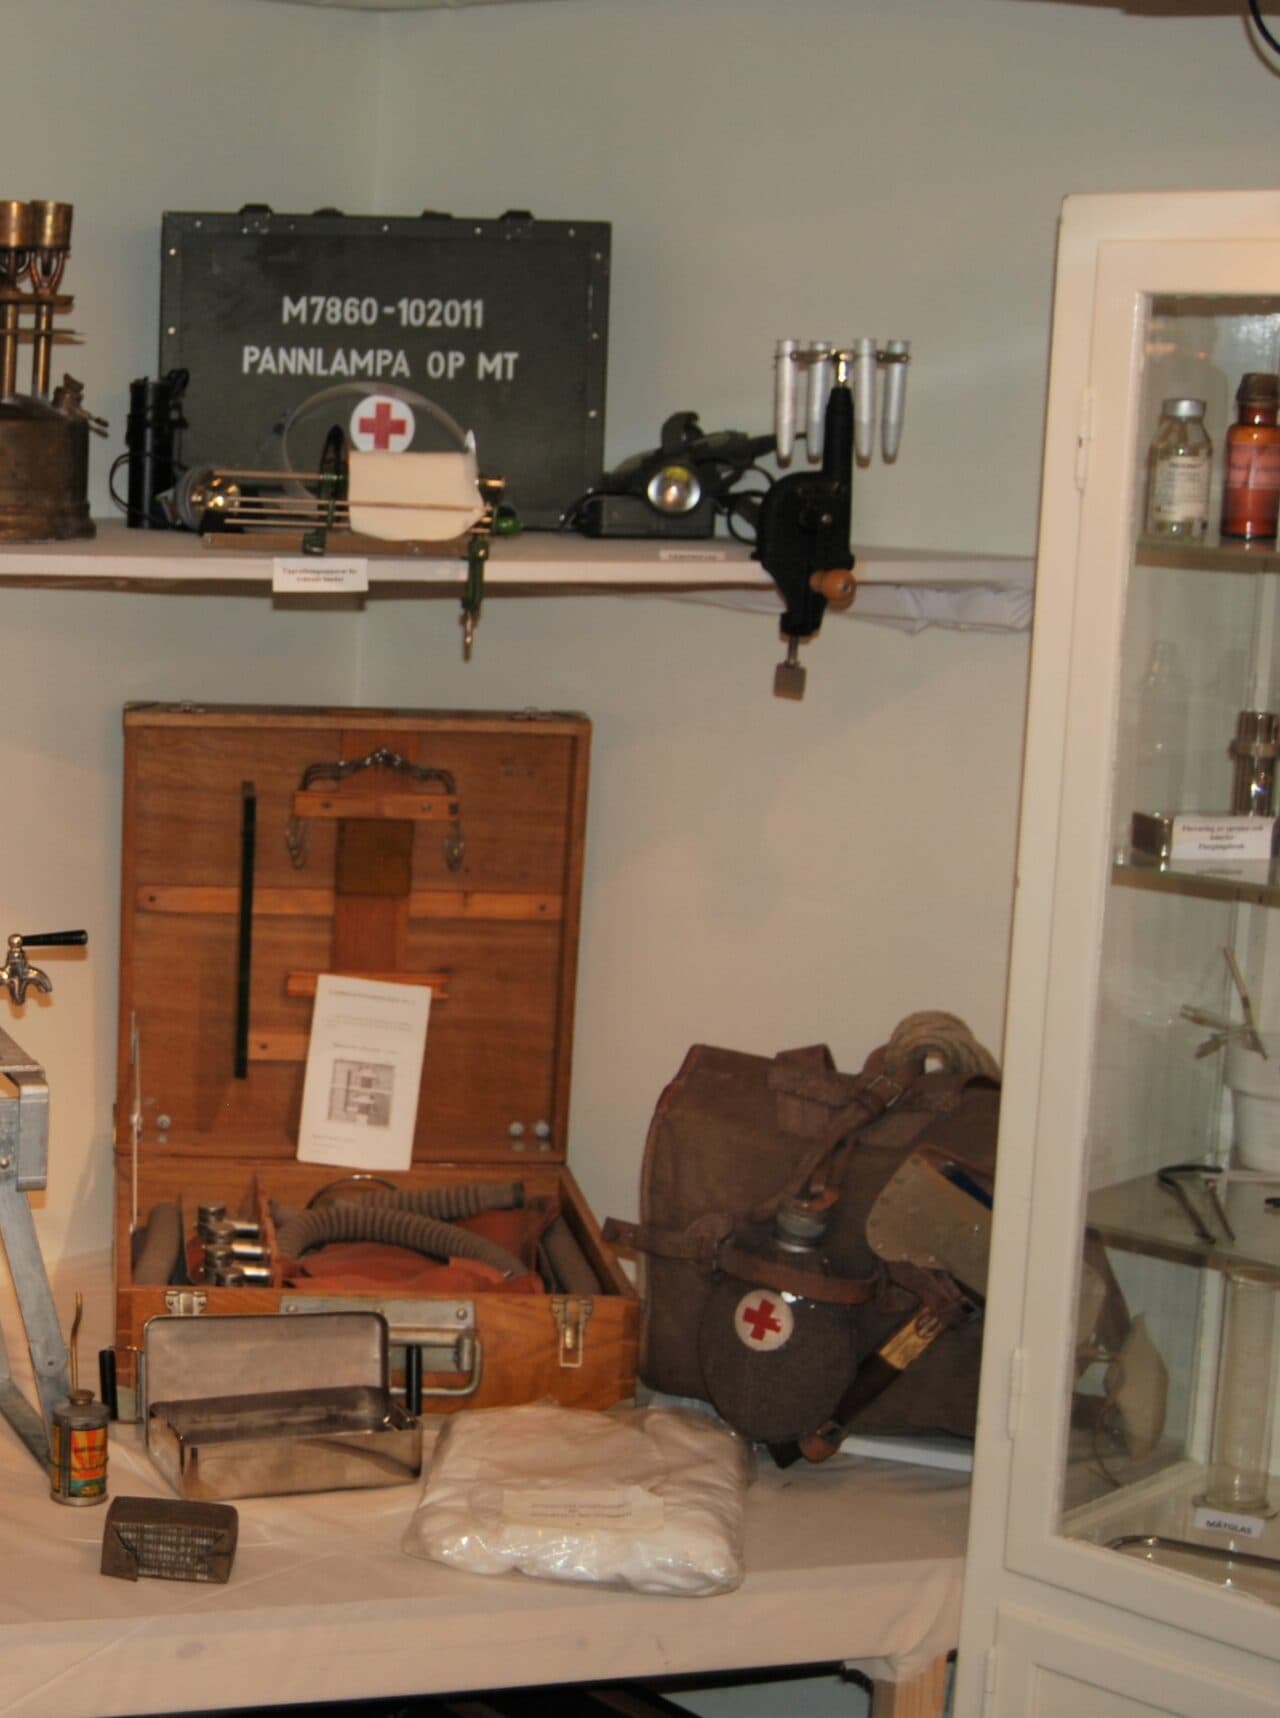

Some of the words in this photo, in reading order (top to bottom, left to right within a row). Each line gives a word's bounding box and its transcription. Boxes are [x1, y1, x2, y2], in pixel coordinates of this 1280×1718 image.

[282, 295, 484, 328] M7860-102011
[241, 345, 411, 378] PANNLAMPA
[426, 350, 466, 380] OP
[477, 352, 519, 381] MT
